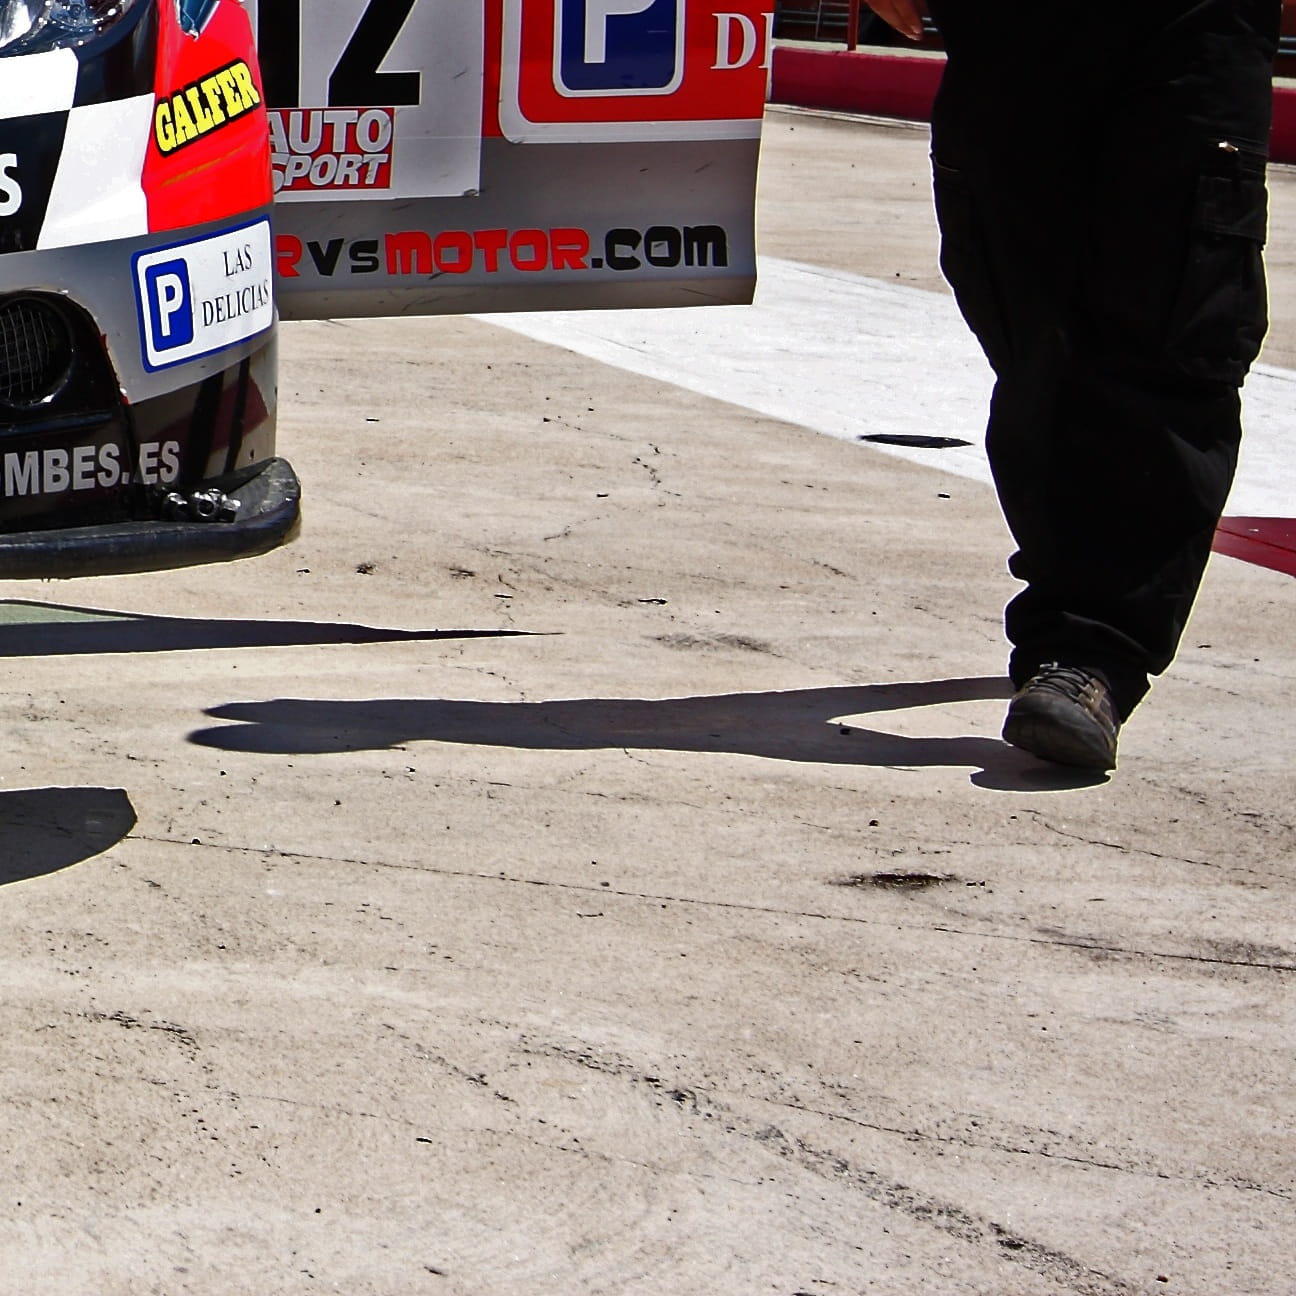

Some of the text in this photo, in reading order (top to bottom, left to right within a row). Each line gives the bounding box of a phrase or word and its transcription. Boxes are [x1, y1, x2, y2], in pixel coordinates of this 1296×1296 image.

[153, 61, 260, 153] GALFER
[157, 243, 253, 337] P LAS
[201, 277, 269, 328] DELICIAS
